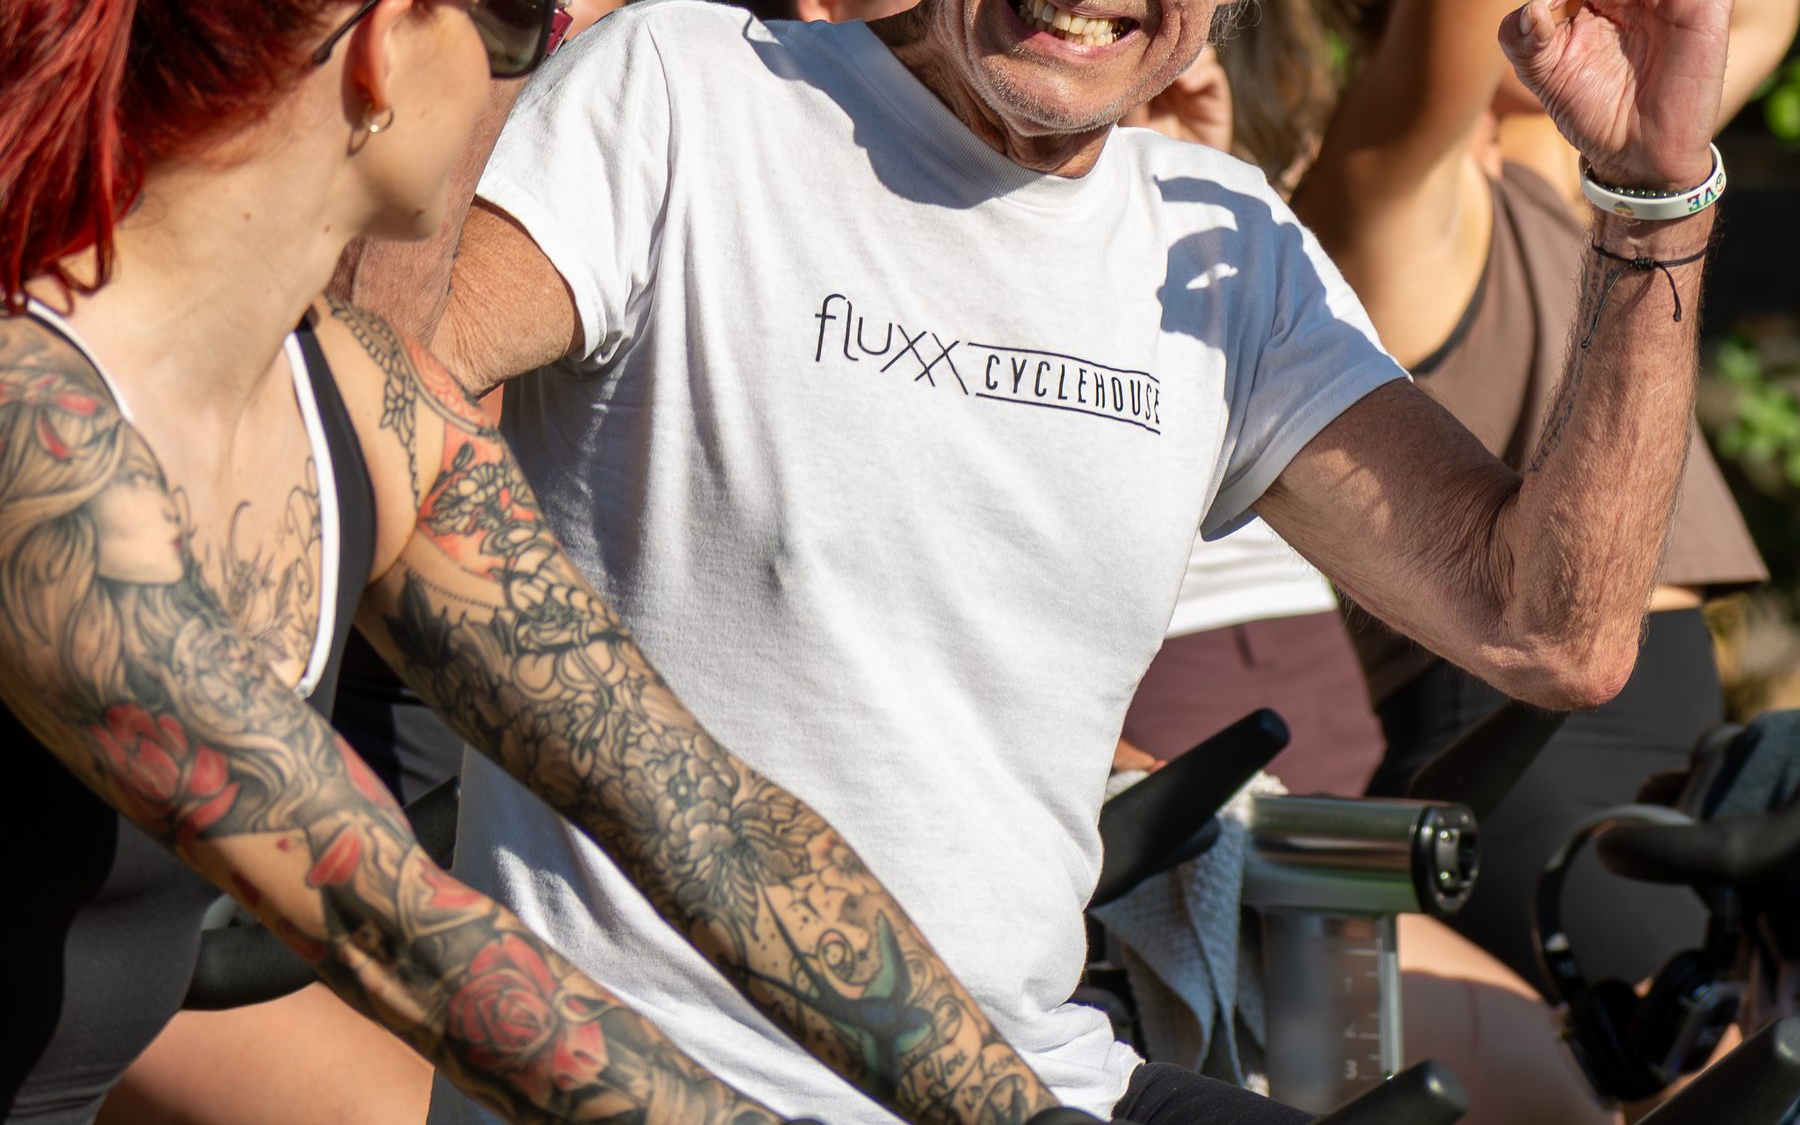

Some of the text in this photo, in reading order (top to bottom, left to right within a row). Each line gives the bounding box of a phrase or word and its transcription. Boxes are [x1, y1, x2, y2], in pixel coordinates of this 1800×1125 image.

[1687, 173, 1724, 212] OVE
[814, 293, 1160, 425] fluxx CYCLEHOUSE
